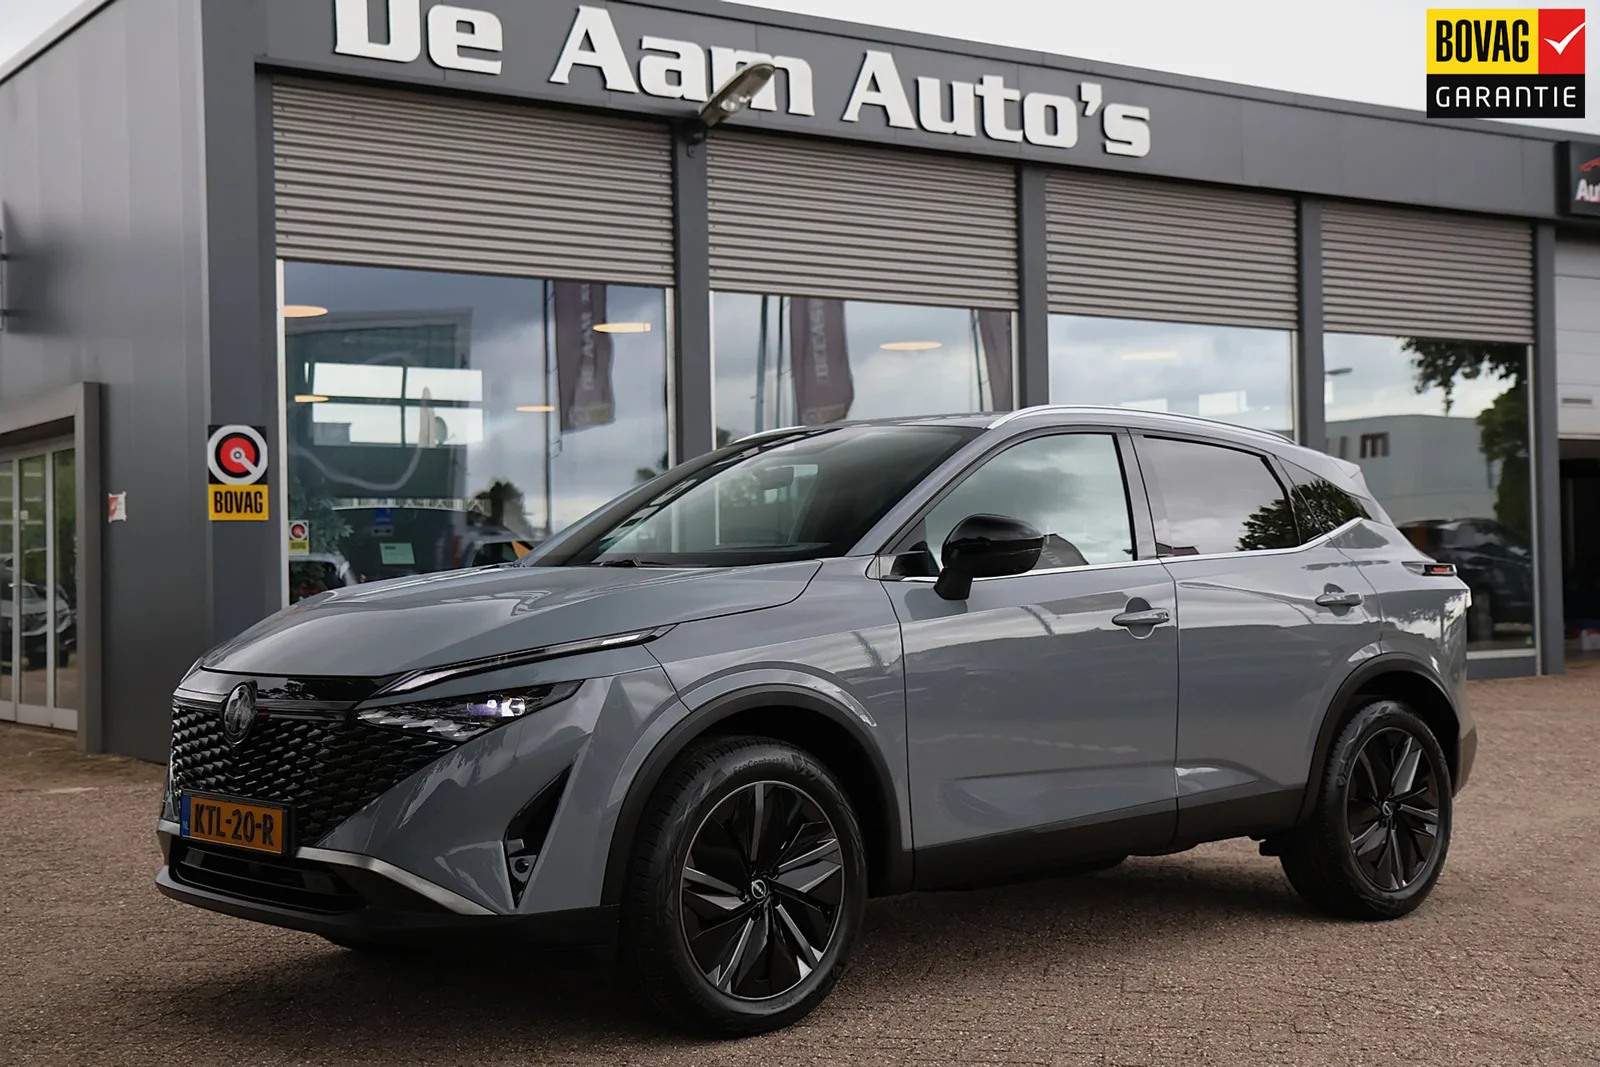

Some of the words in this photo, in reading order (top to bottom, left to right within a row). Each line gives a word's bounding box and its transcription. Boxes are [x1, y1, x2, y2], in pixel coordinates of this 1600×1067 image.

[333, 0, 503, 75] De
[549, 4, 815, 117] Aam
[842, 50, 1151, 158] Auto's
[1575, 178, 1600, 204] Au
[213, 490, 264, 514] BOVAG
[194, 803, 275, 847] KTL-20-R
